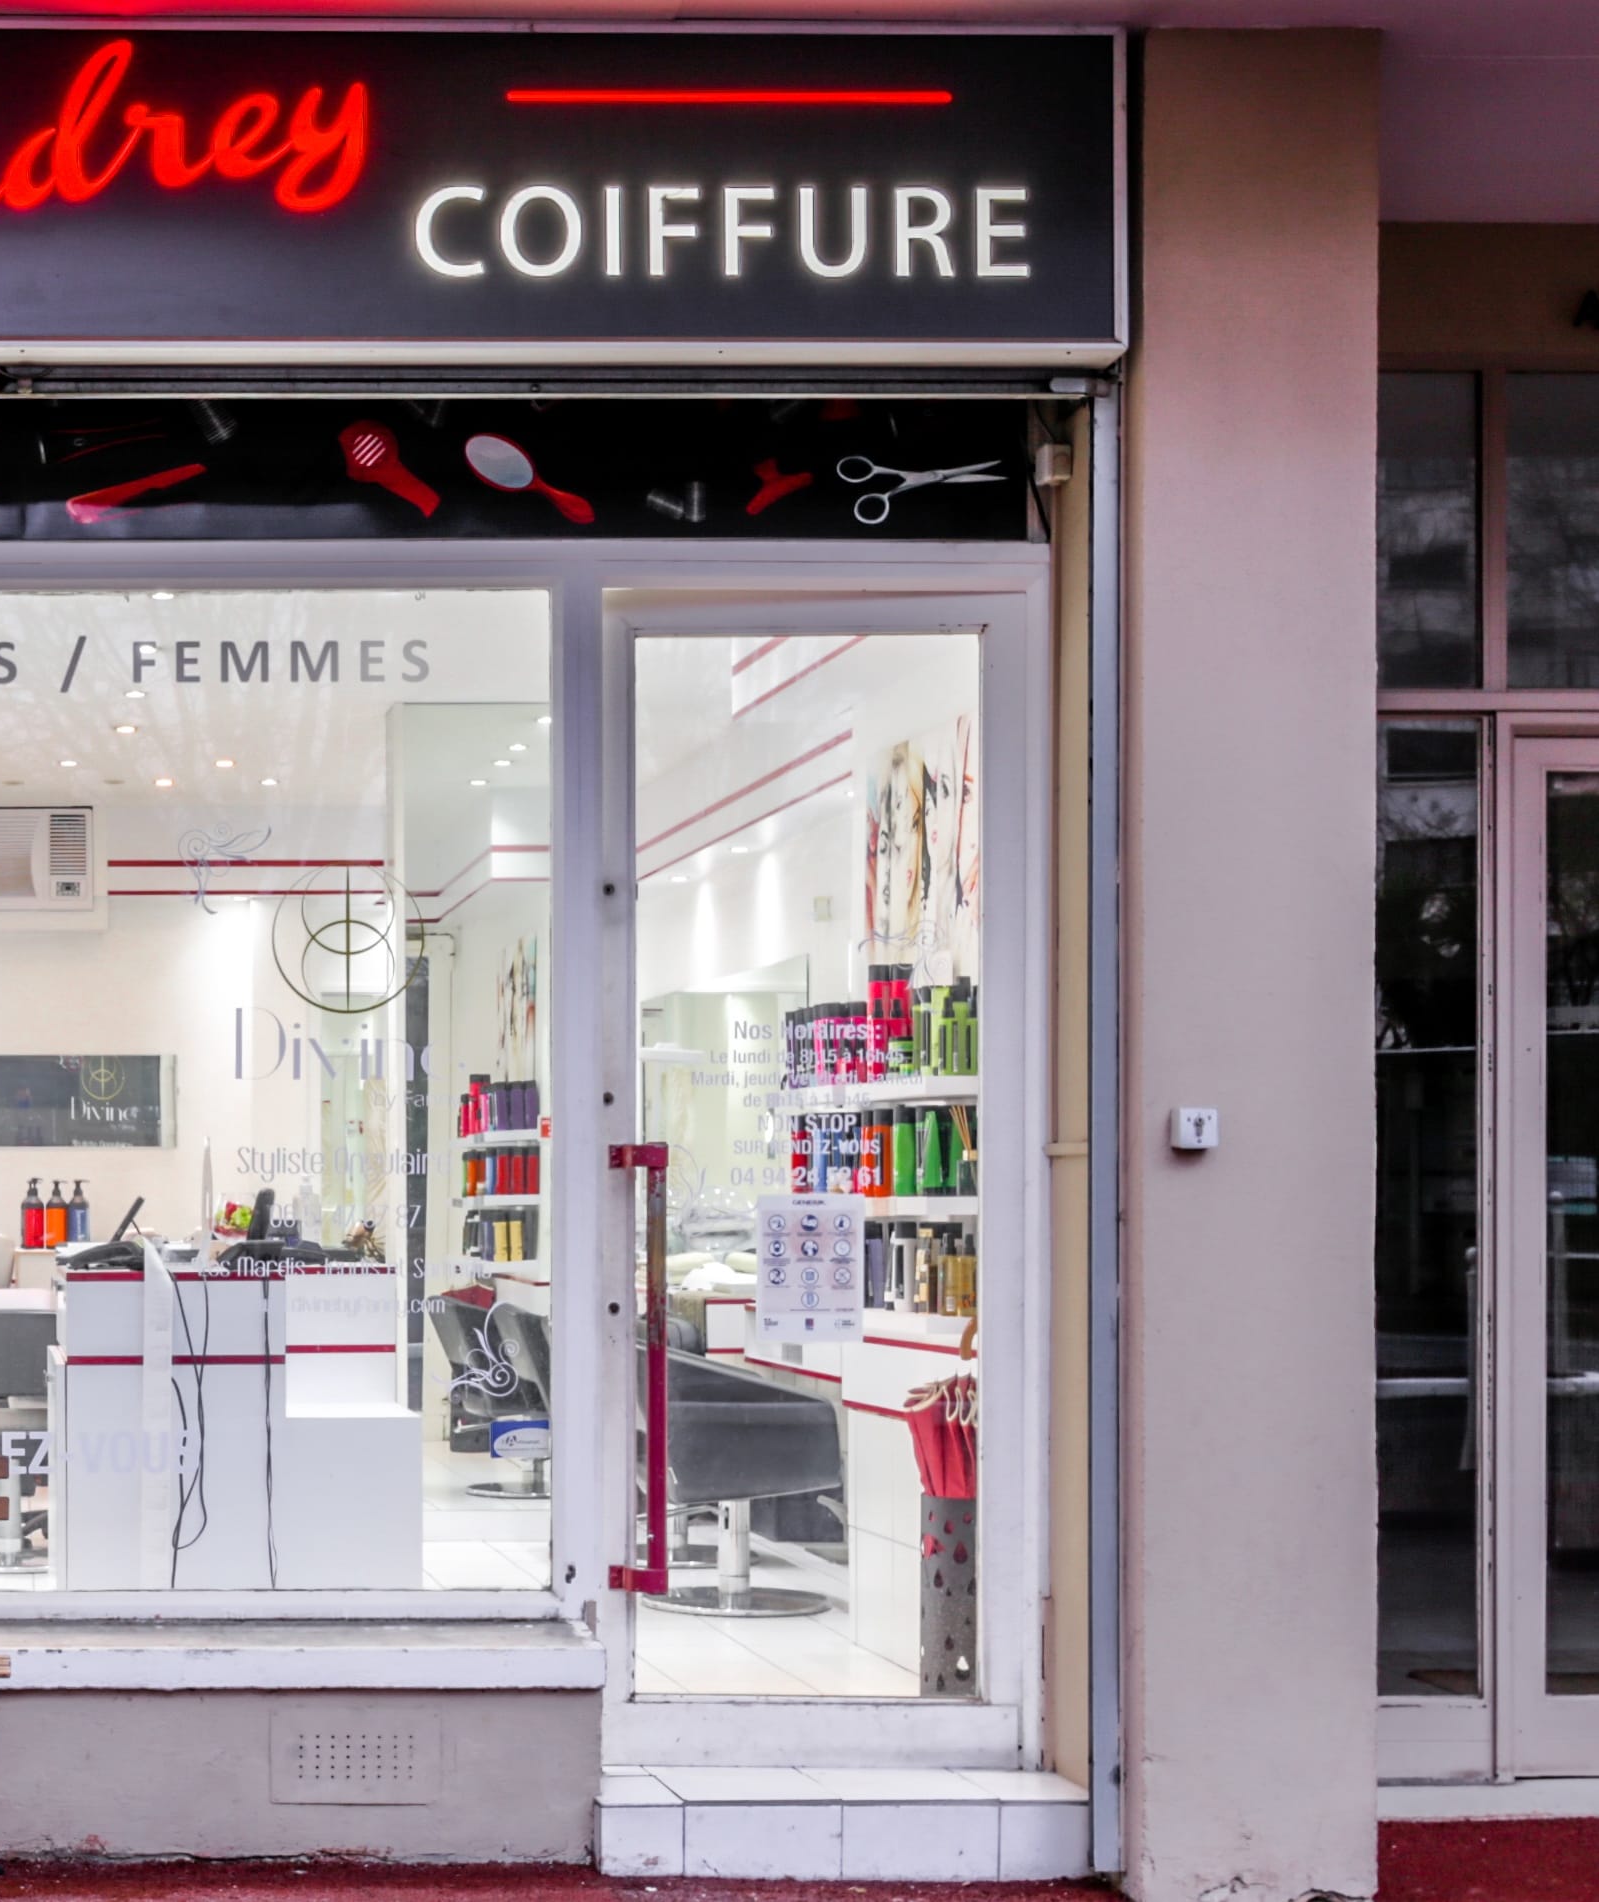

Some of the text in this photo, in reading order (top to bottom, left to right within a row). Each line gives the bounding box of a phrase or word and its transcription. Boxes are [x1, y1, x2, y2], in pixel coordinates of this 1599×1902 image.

[414, 184, 1031, 278] COIFFURE
[60, 635, 87, 693] /
[132, 639, 431, 684] FEMMES
[734, 1020, 868, 1040] Nos Horaires
[710, 1050, 728, 1064] Le
[733, 1050, 770, 1064] lundi
[842, 1048, 852, 1064] à
[691, 1072, 739, 1088] Mardi,
[743, 1092, 761, 1108] de
[766, 1092, 803, 1108] h15
[757, 1114, 857, 1132] NON STOP
[733, 1139, 880, 1154] SUR RENDEZ-VOUS
[236, 1146, 325, 1183] Styliste
[730, 1167, 754, 1186] 04
[762, 1167, 787, 1186] 94
[857, 1166, 881, 1186] 61
